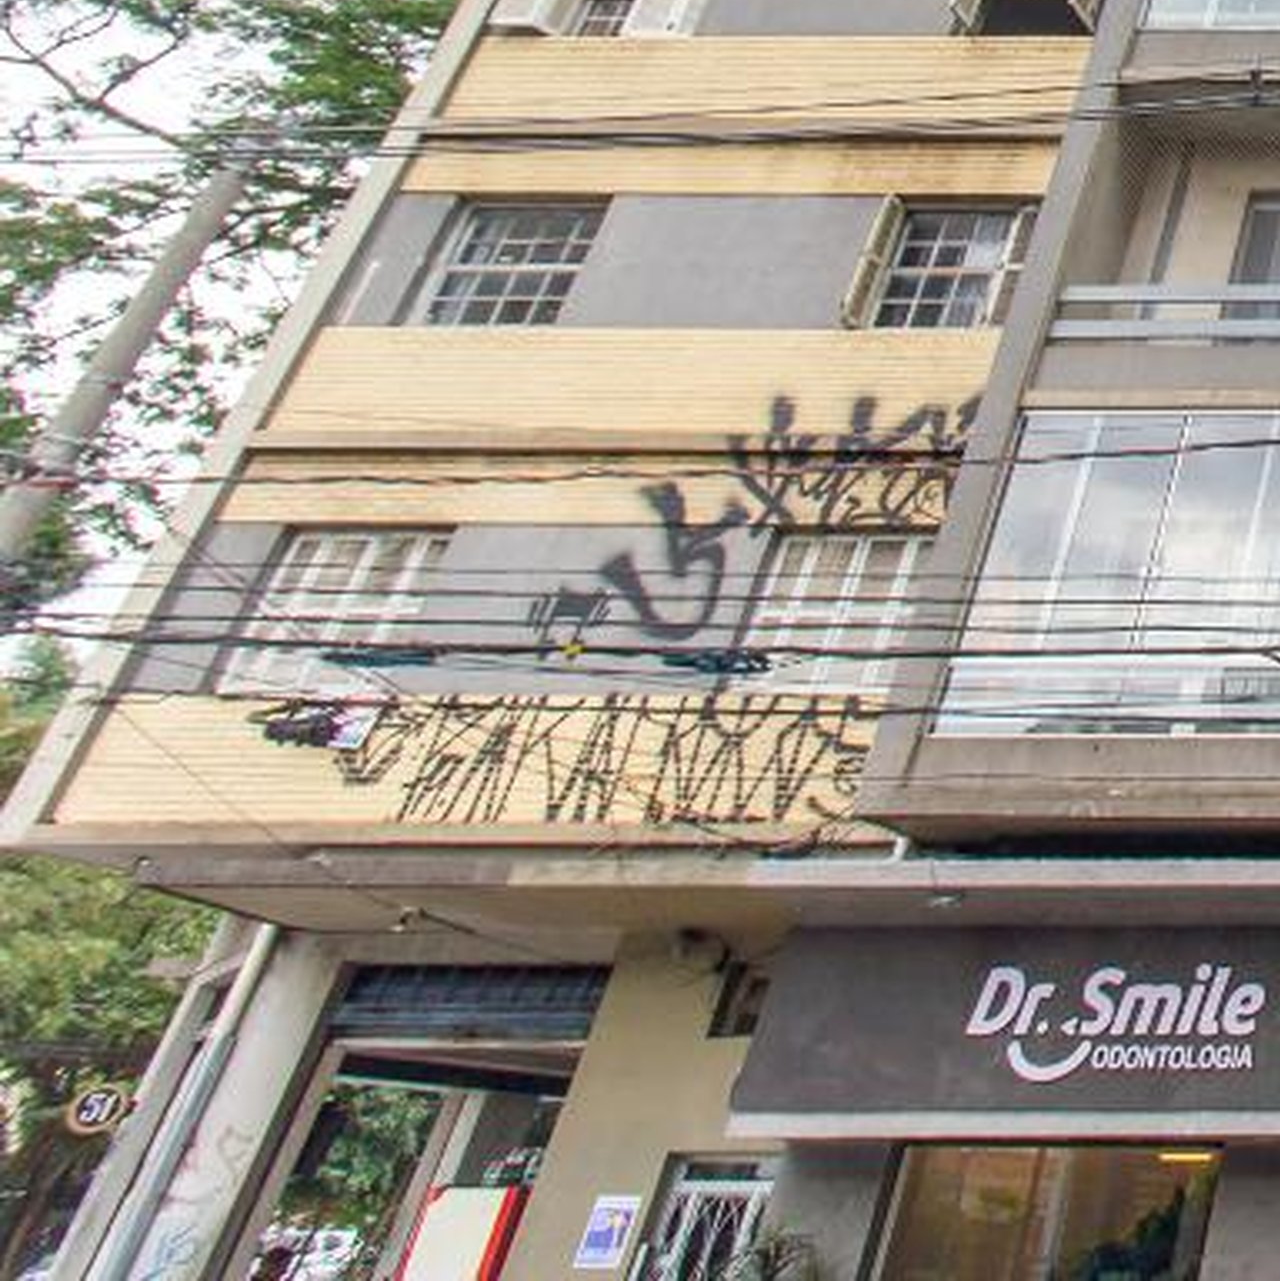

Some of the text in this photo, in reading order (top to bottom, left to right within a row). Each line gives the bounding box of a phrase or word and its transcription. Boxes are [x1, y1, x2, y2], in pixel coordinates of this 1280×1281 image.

[965, 964, 1266, 1036] Dr. Smile
[1091, 1044, 1253, 1069] ODONTOLOGIA
